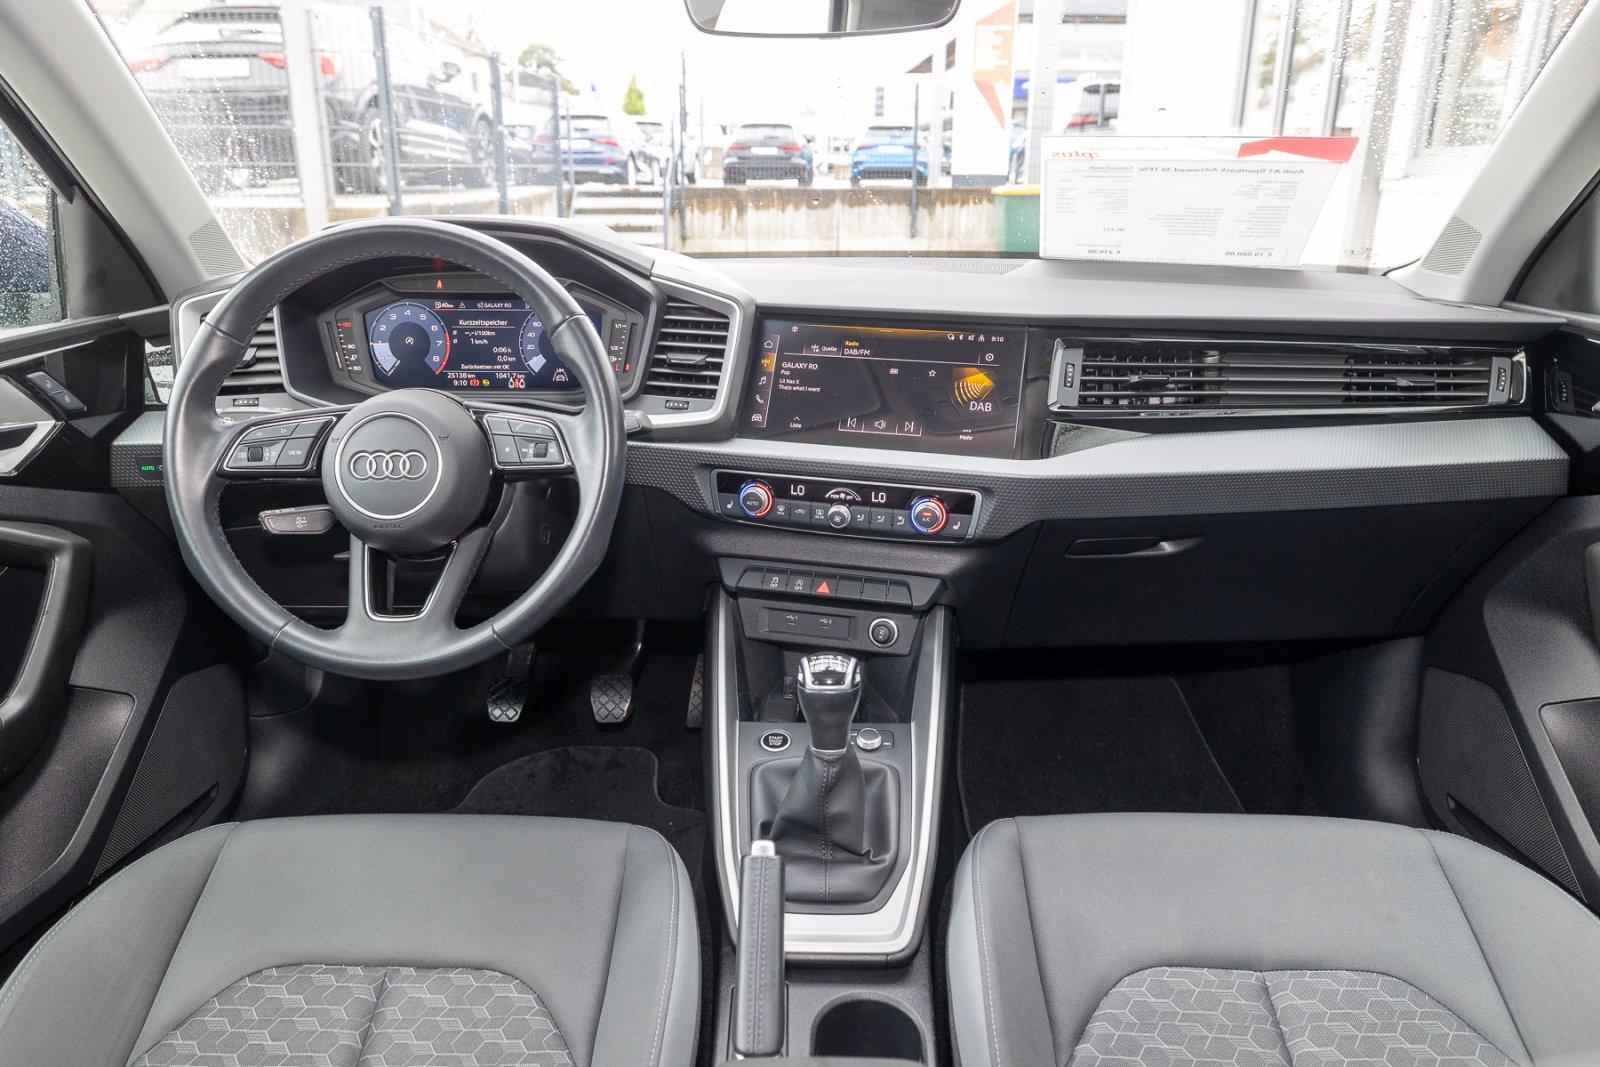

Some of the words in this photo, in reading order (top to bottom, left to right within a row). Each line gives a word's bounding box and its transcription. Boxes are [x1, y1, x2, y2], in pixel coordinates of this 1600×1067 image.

[459, 319, 508, 327] Kurzzeitspeicher
[844, 348, 871, 356] DAB/FM
[782, 361, 807, 370] GALAXY
[969, 401, 993, 412] DAB
[790, 484, 805, 496] LO
[871, 491, 887, 503] LO
